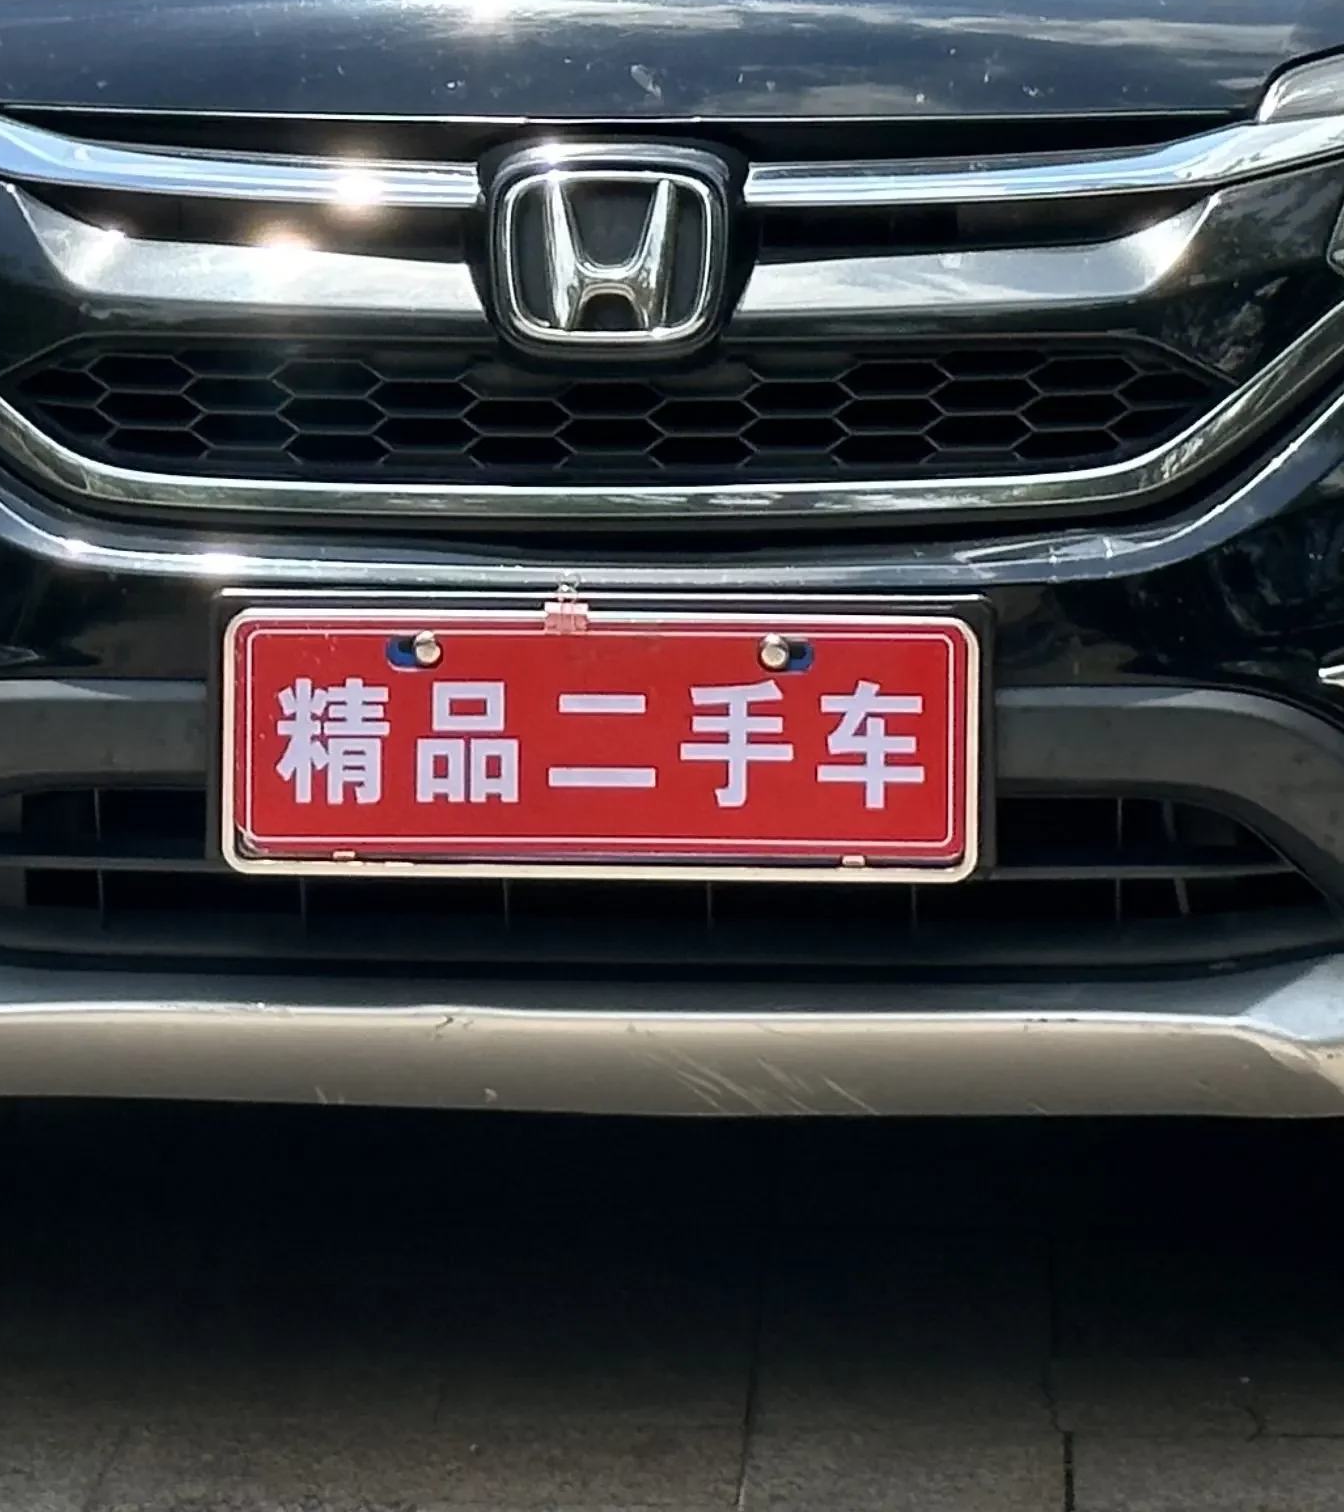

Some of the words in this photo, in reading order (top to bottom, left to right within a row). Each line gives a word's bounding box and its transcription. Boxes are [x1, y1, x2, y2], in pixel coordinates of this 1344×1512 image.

[276, 678, 926, 810] 精品二手车
